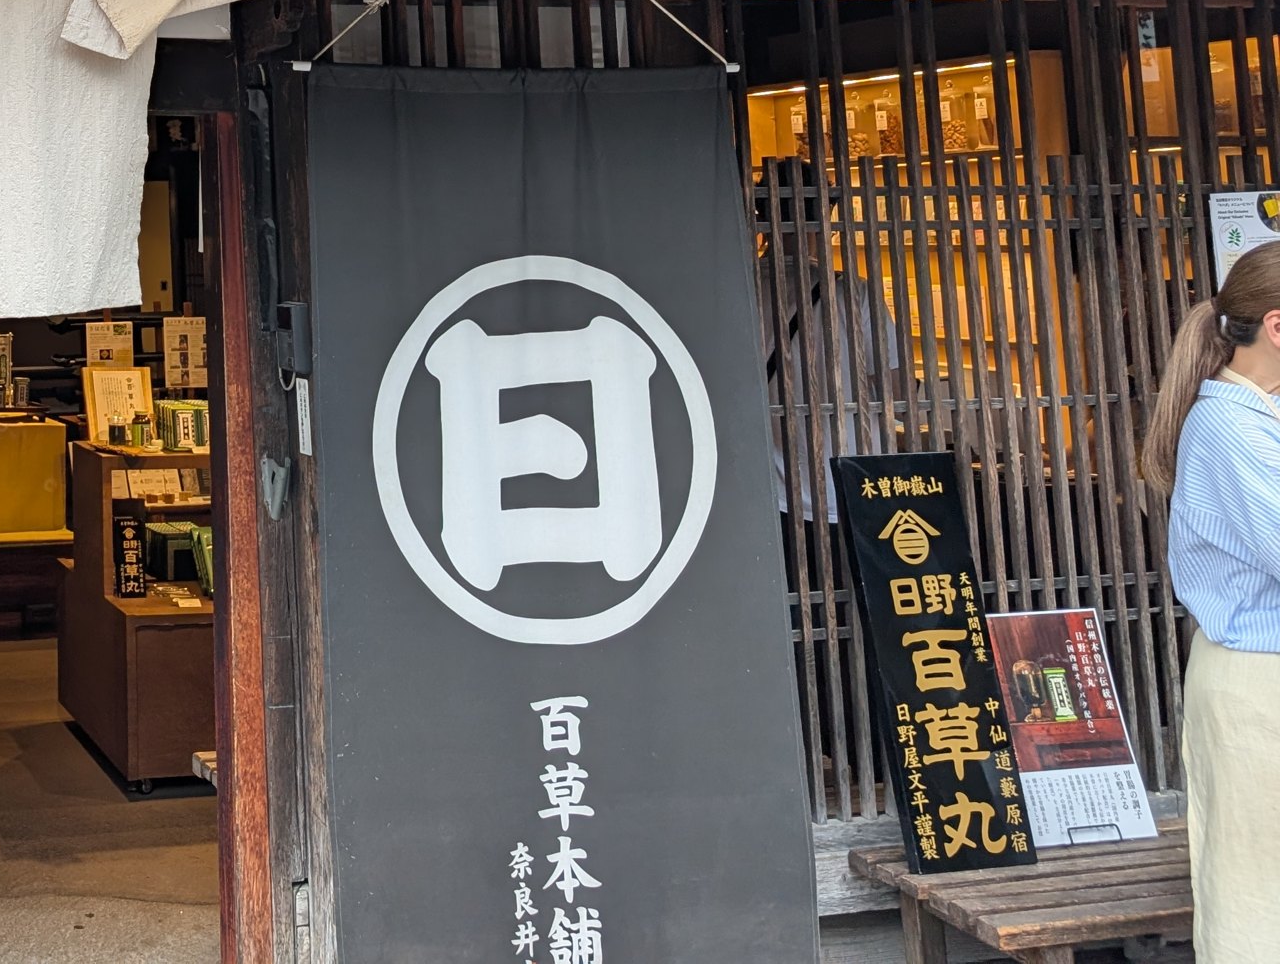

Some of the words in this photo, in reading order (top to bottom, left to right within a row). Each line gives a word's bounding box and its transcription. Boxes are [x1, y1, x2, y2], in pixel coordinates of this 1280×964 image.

[959, 571, 989, 663] 天明年間創業
[895, 703, 941, 861] 日野屋文平謹製
[508, 842, 540, 964] 奈良井
